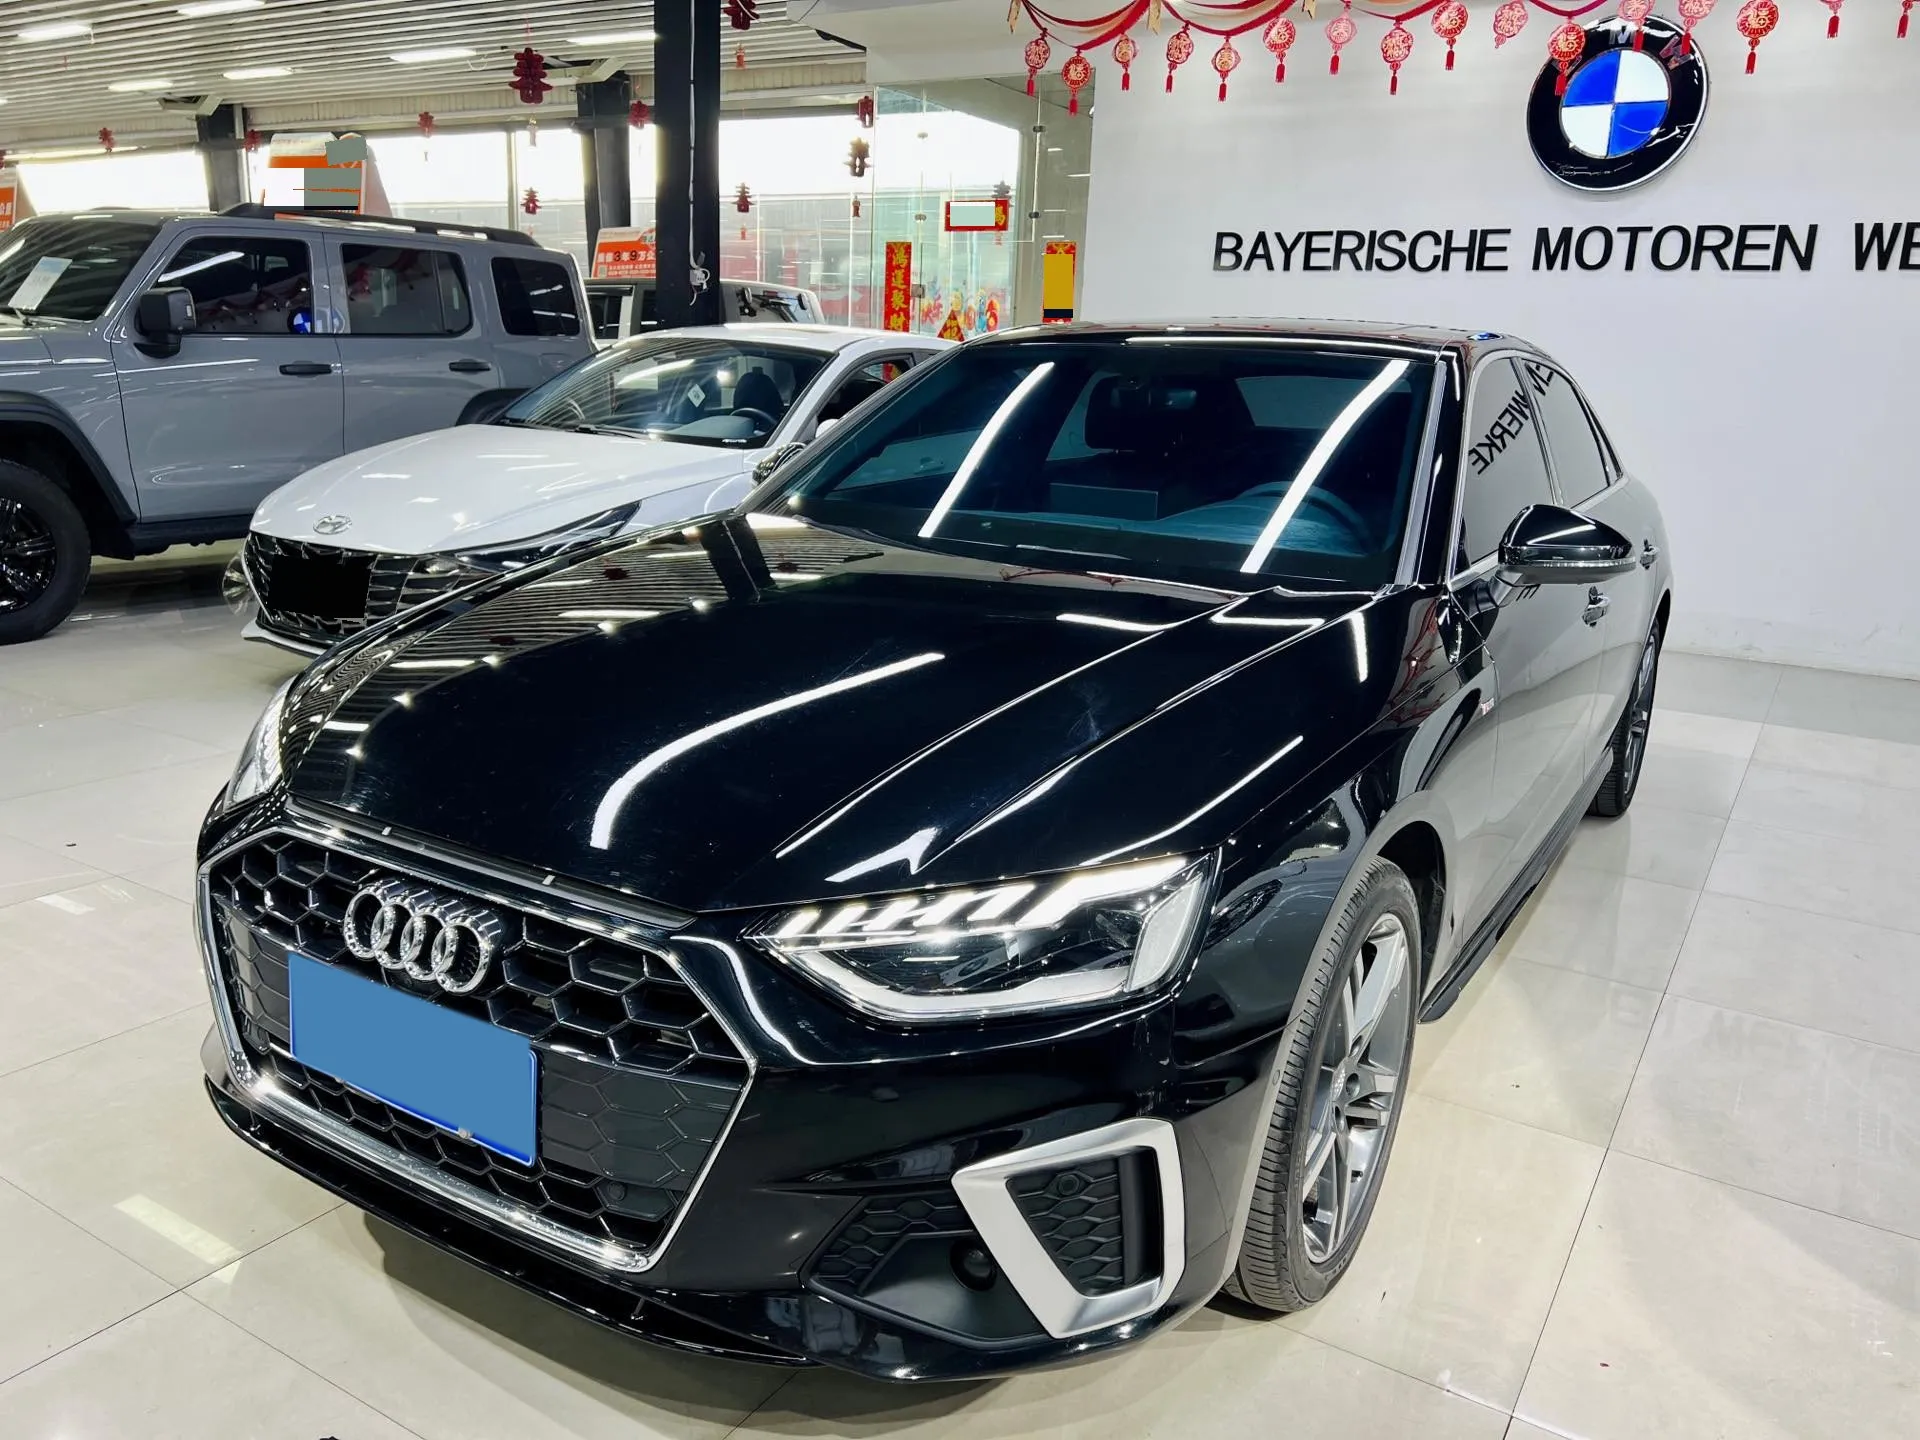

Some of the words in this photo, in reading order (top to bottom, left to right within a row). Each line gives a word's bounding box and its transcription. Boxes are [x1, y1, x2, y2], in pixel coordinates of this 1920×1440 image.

[1214, 229, 1511, 272] BAYERISCHE
[1532, 224, 1818, 271] MOTOREN
[1855, 222, 1920, 270] WE
